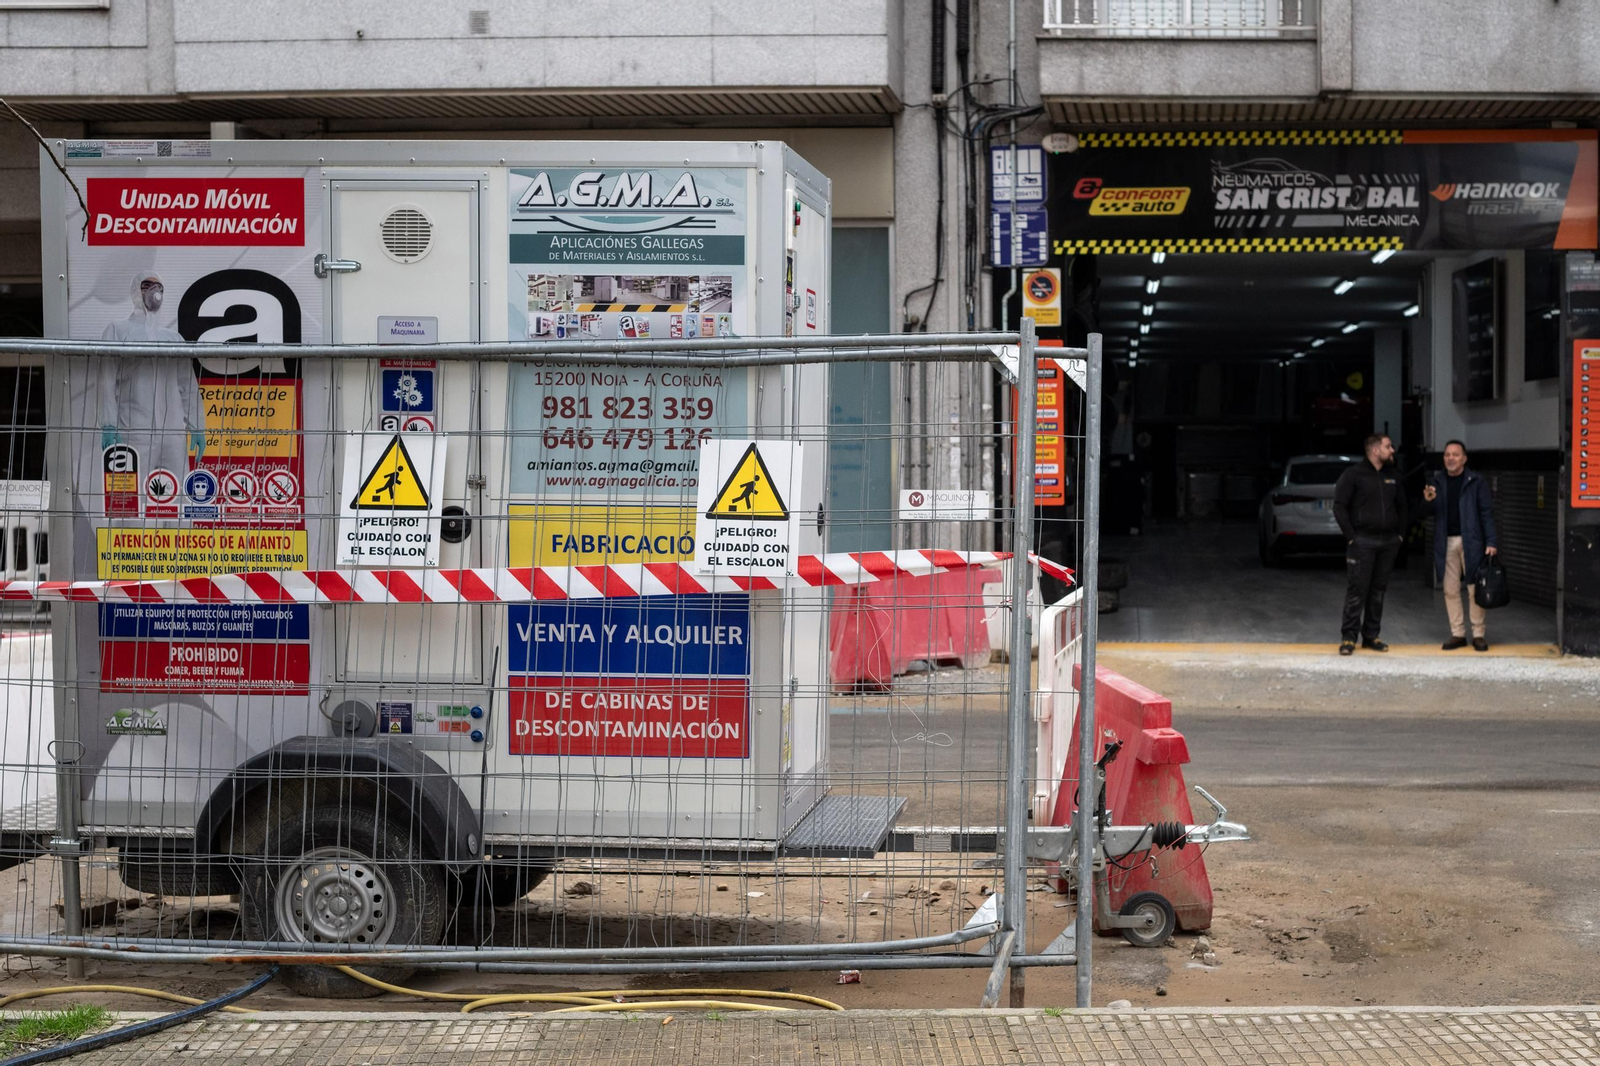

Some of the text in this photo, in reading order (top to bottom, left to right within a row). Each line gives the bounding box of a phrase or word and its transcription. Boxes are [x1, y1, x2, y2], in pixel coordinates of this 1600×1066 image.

[1213, 173, 1316, 187] NEUMATICOS
[120, 188, 271, 210] UNIDAD MÓVIL
[1101, 189, 1187, 200] CONFORT
[1214, 186, 1271, 210] SAN
[1131, 200, 1175, 212] auto
[94, 213, 297, 234] DESCONTAMINACIÓN
[1346, 214, 1419, 227] MECANICA
[640, 237, 704, 250] GALLEGAS
[549, 252, 560, 260] DE
[563, 251, 615, 261] MATERIALES
[618, 252, 624, 260] Y
[626, 251, 690, 261] AISLAMIENTOS
[394, 320, 414, 328] ACCESO
[390, 328, 425, 336] MAQUINARIA
[534, 371, 586, 386] 15200
[591, 373, 628, 386] NOIA
[644, 373, 656, 386] A
[661, 371, 723, 387] CORUÑA
[267, 387, 287, 401] de
[207, 404, 275, 418] Amianto
[542, 396, 713, 420] 981 823 359
[206, 436, 219, 446] de
[542, 427, 594, 450] 646
[602, 427, 653, 450] 479
[527, 458, 698, 474] amiantos.agma@gmail.
[546, 475, 699, 489] www.agmagalicia.co
[926, 494, 976, 502] MAQUINOR
[359, 517, 419, 528] ¡PELIGRO!
[347, 532, 432, 543] CUIDADO CON
[716, 527, 777, 538] ¡PELIGRO!
[113, 531, 291, 550] ATENCIÓN RIESGO DE AMIANTO
[552, 531, 696, 555] FABRICACIÓ
[350, 546, 426, 557] EL ESCALON
[704, 542, 790, 553] CUIDADO CON
[158, 553, 168, 561] EN
[178, 553, 198, 561] ZONA
[199, 553, 206, 561] SI
[220, 553, 229, 562] LO
[265, 554, 273, 562] EL
[274, 554, 304, 563] TRABAJO
[707, 556, 785, 567] EL ESCALON
[112, 564, 121, 572] ES
[121, 564, 149, 573] POSIBLE
[114, 608, 144, 618] UTILIZAR
[145, 608, 175, 618] EQUIPOS
[176, 609, 186, 618] DE
[192, 622, 215, 631] BUZOS
[516, 622, 743, 647] VENTA Y ALQUILER
[170, 646, 239, 663] PROHIBIDO
[192, 666, 213, 675] BEBER
[220, 667, 245, 676] FUMAR
[545, 692, 709, 711] DE CABINAS DE
[515, 718, 740, 740] DESCONTAMINACIÓN
